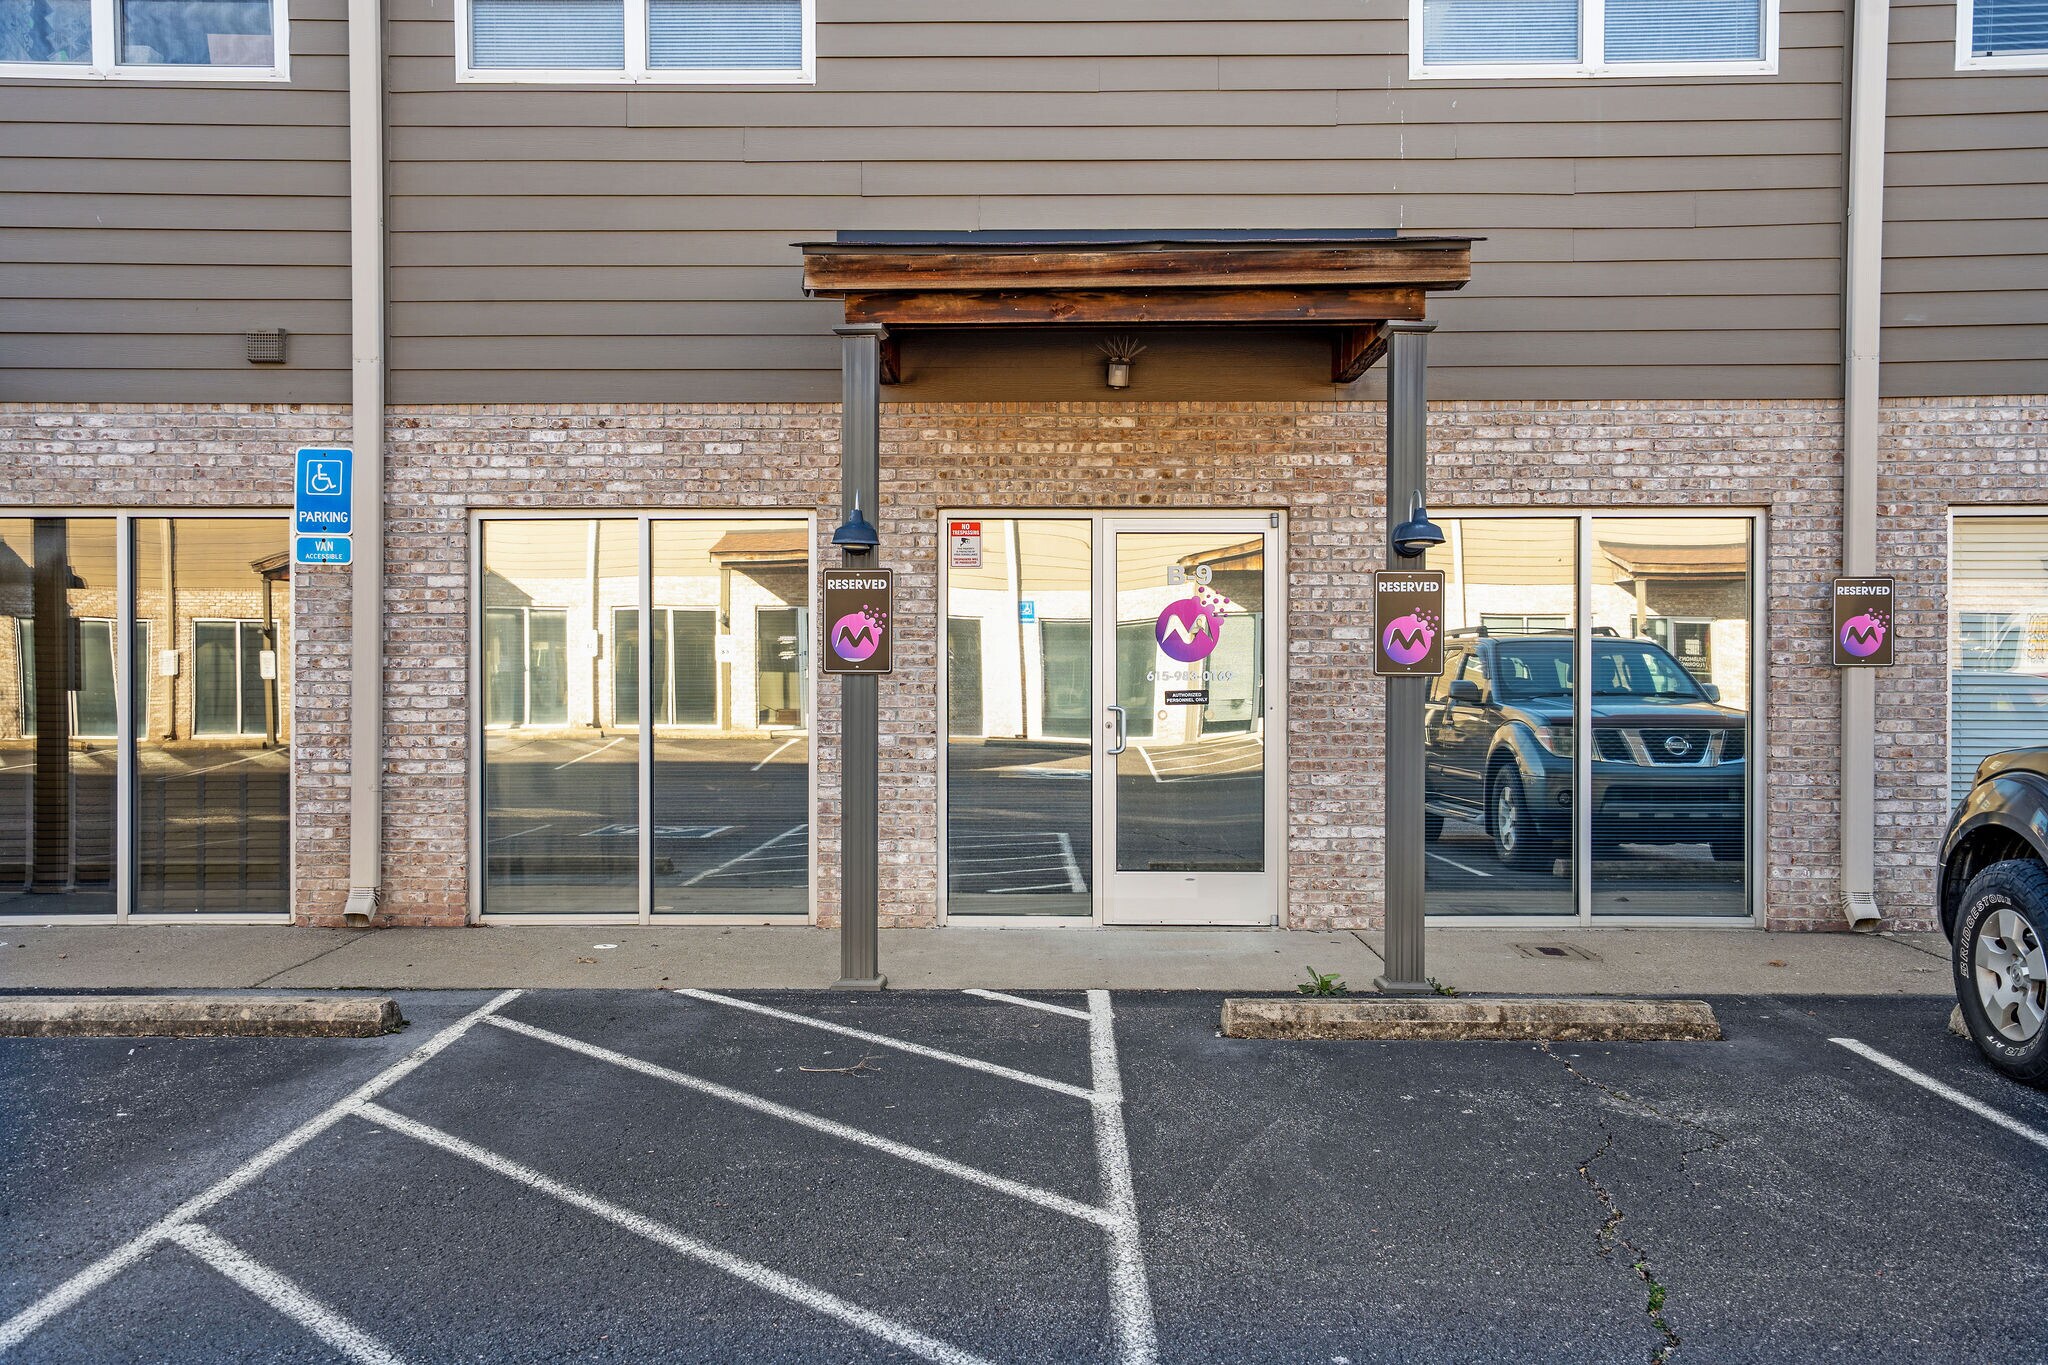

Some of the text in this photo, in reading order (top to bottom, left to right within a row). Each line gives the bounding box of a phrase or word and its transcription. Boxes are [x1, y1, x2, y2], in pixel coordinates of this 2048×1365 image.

[299, 511, 348, 523] PARKING
[315, 541, 334, 551] VAN
[1167, 564, 1213, 586] B-9
[827, 579, 888, 590] RESERVED
[1378, 581, 1440, 592] RESERVED
[1836, 586, 1890, 596] RESERVED
[1146, 671, 1233, 681] 615-983-0169
[1960, 894, 2012, 979] BRIDGESTONE
[1986, 1035, 2006, 1048] A/T
